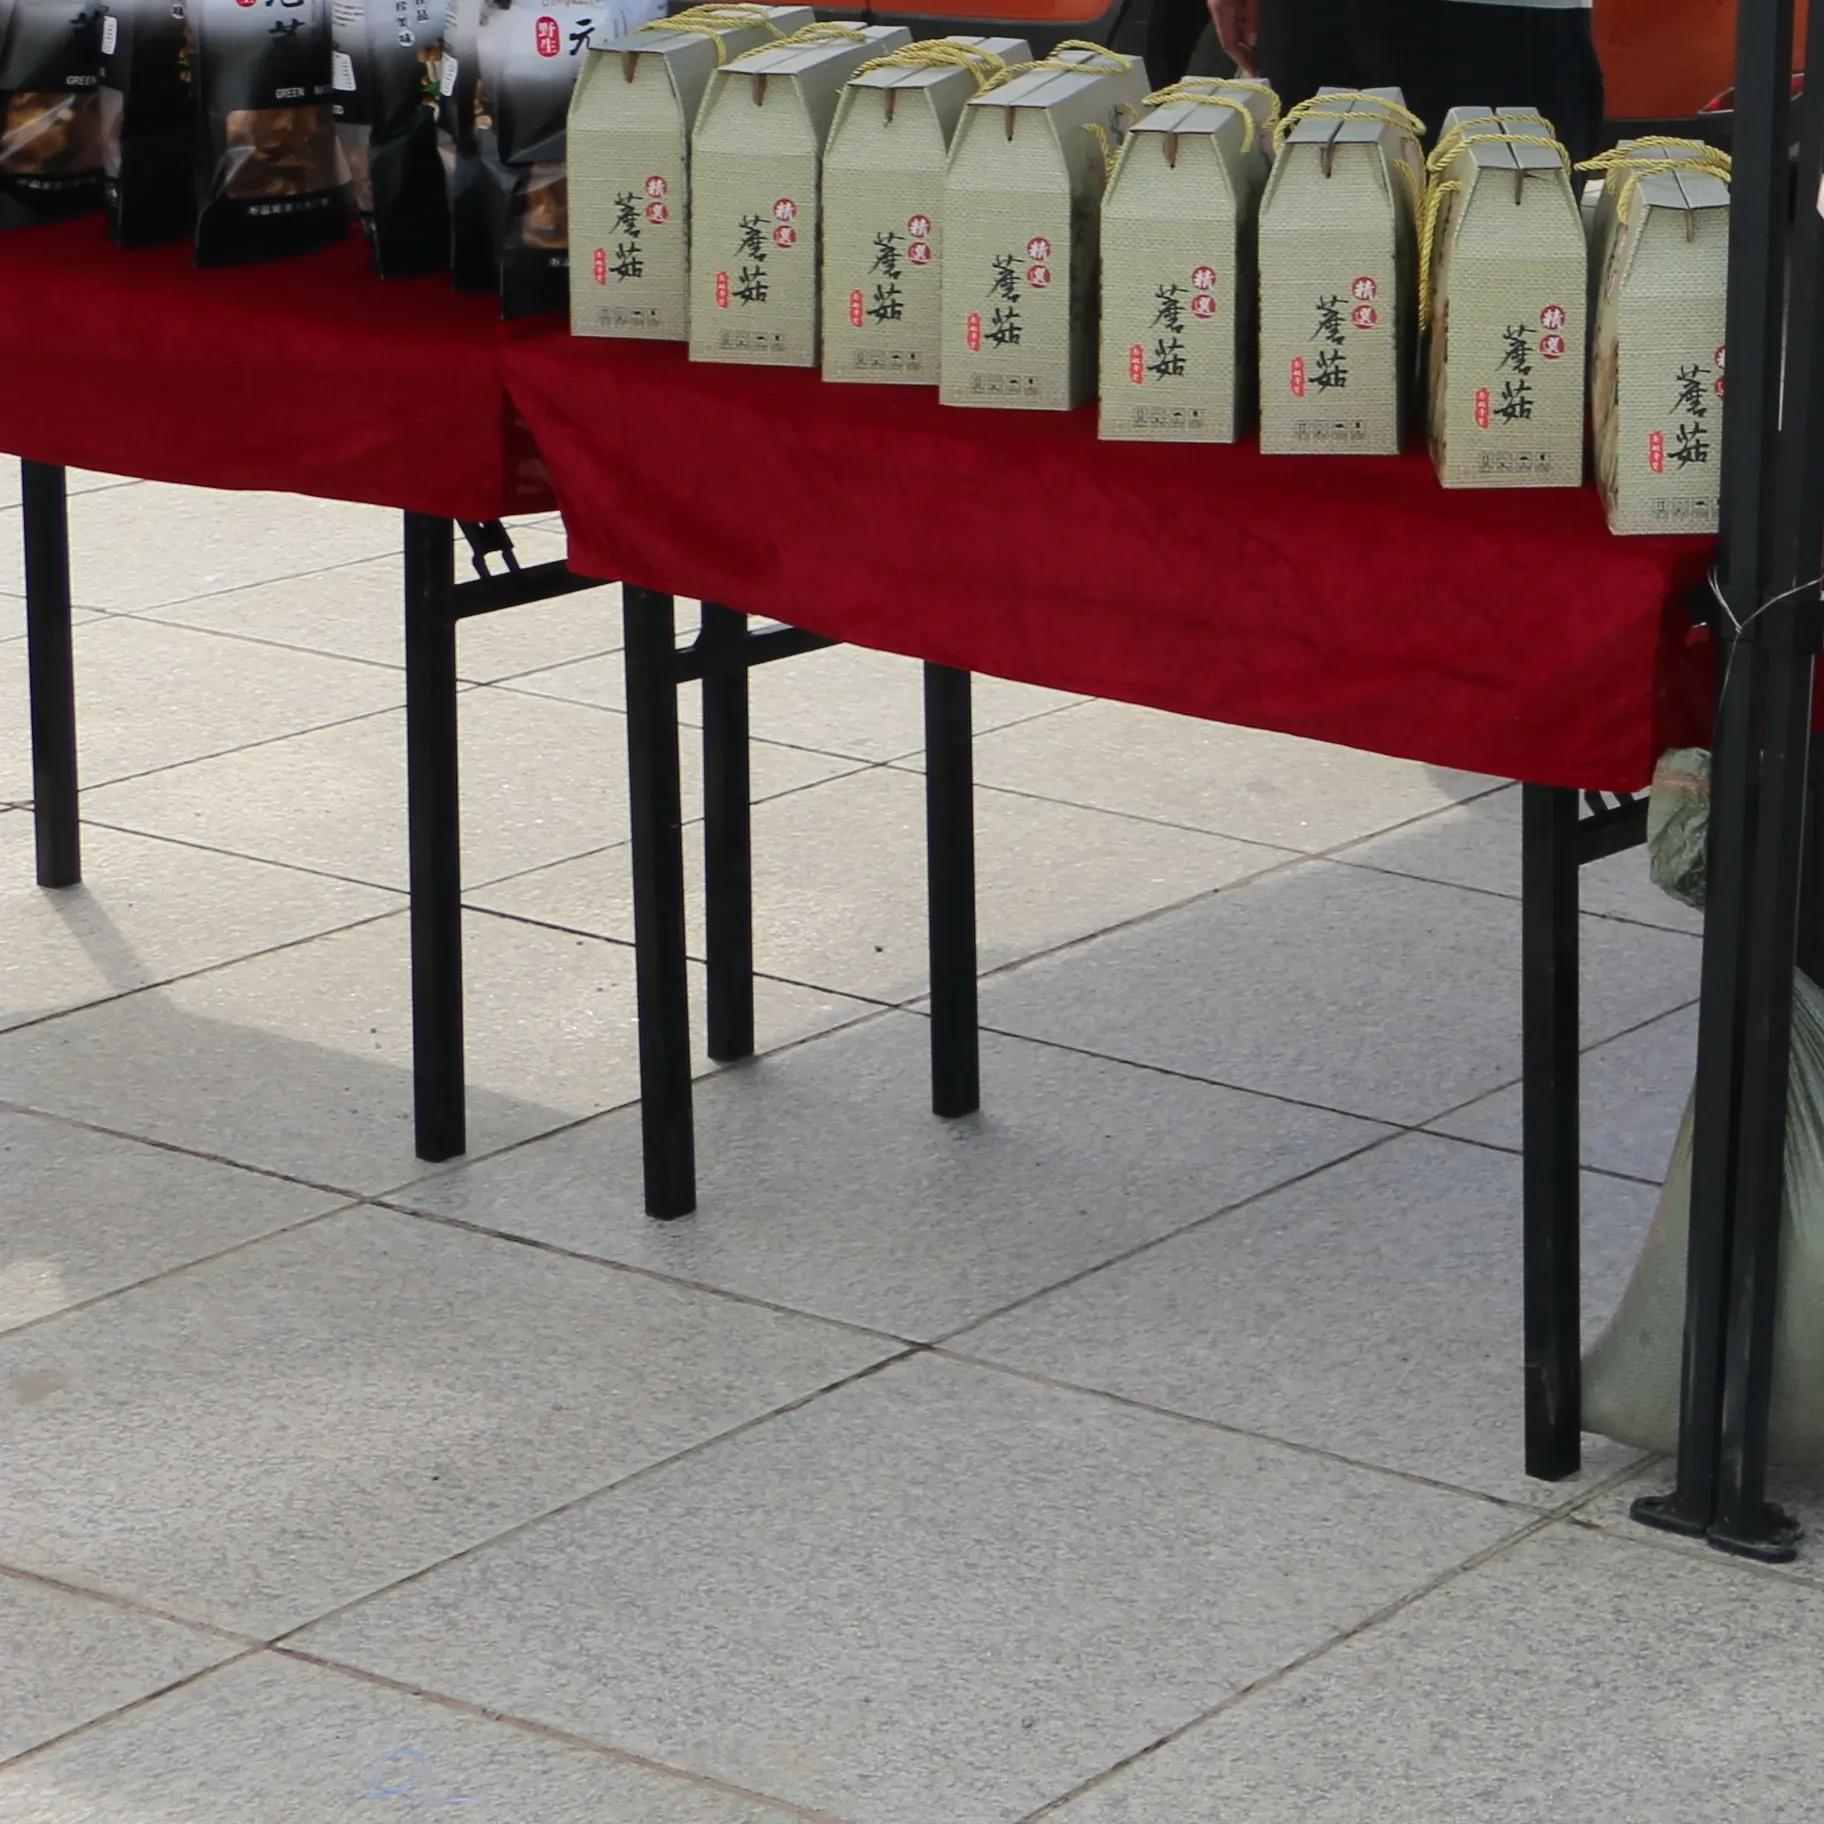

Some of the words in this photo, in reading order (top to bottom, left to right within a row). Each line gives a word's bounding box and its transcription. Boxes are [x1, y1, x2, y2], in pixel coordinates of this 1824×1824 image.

[536, 16, 560, 57] 野生
[609, 191, 645, 283] 蘑菇
[732, 214, 771, 306] 蘑菇
[866, 231, 905, 325] 蘑菇
[984, 253, 1025, 349] 蘑菇
[1147, 283, 1190, 381] 蘑菇
[1309, 294, 1349, 394] 蘑菇
[1494, 324, 1538, 425] 蘑菇
[1667, 363, 1711, 470] 蘑菇
